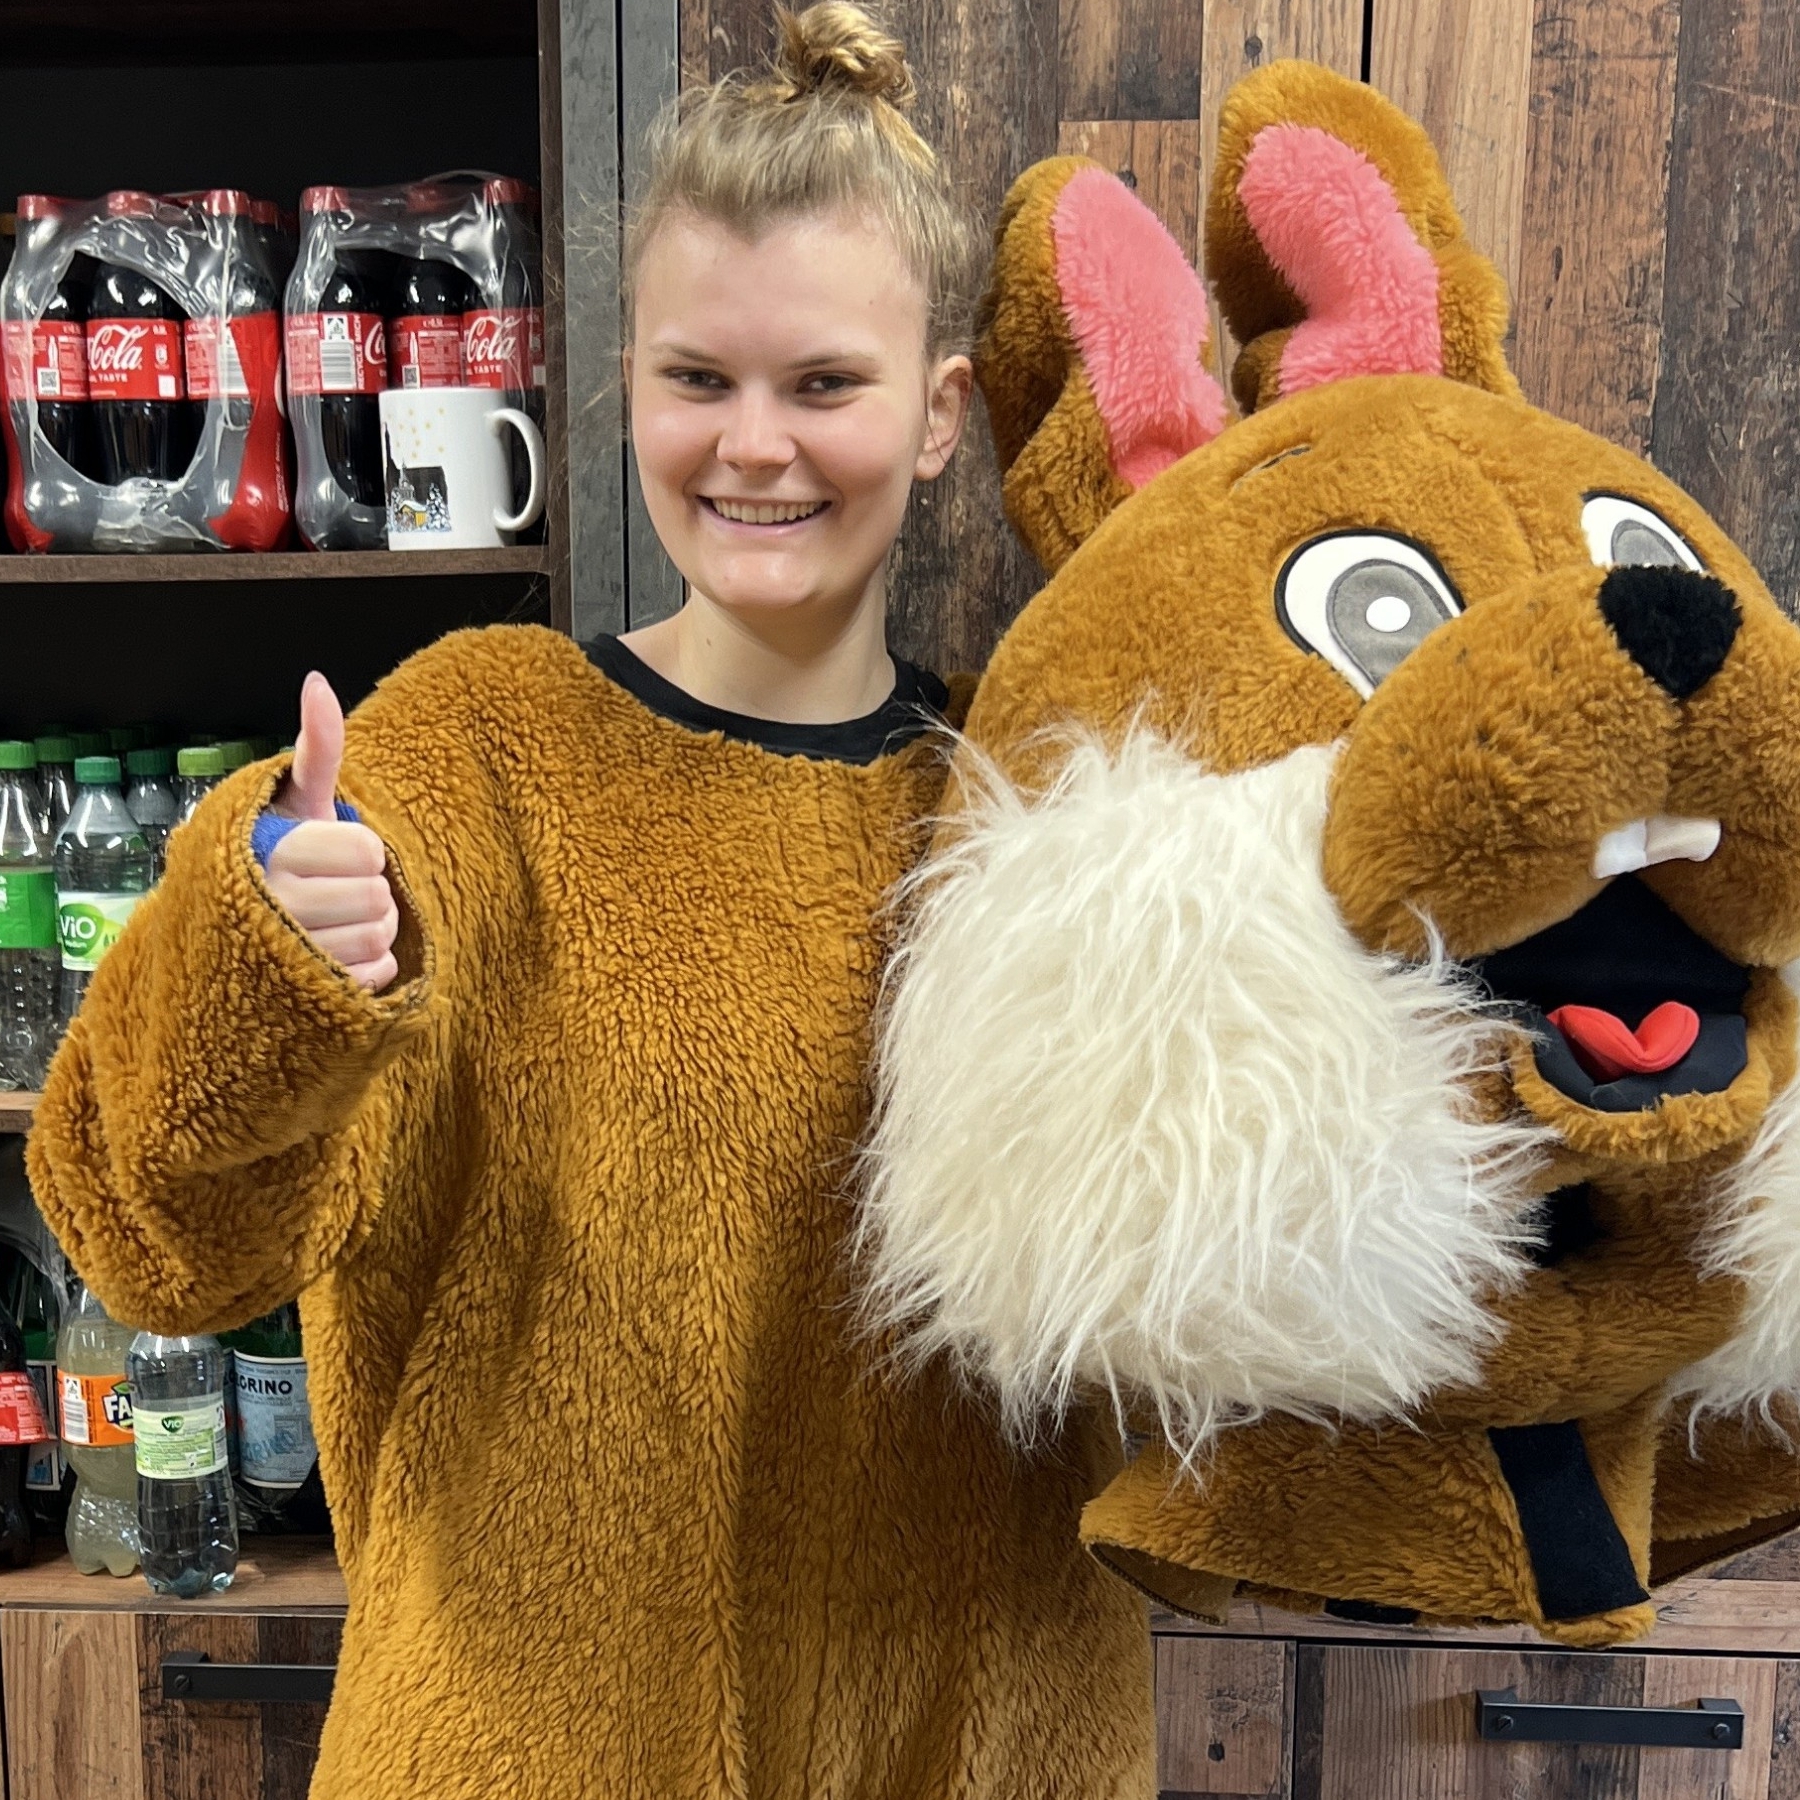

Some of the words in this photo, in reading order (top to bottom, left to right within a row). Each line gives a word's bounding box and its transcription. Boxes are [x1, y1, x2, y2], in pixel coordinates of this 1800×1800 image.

[90, 324, 149, 371] Cola
[467, 315, 523, 364] Cola
[235, 1374, 292, 1395] GRINO
[103, 1395, 133, 1422] FA
